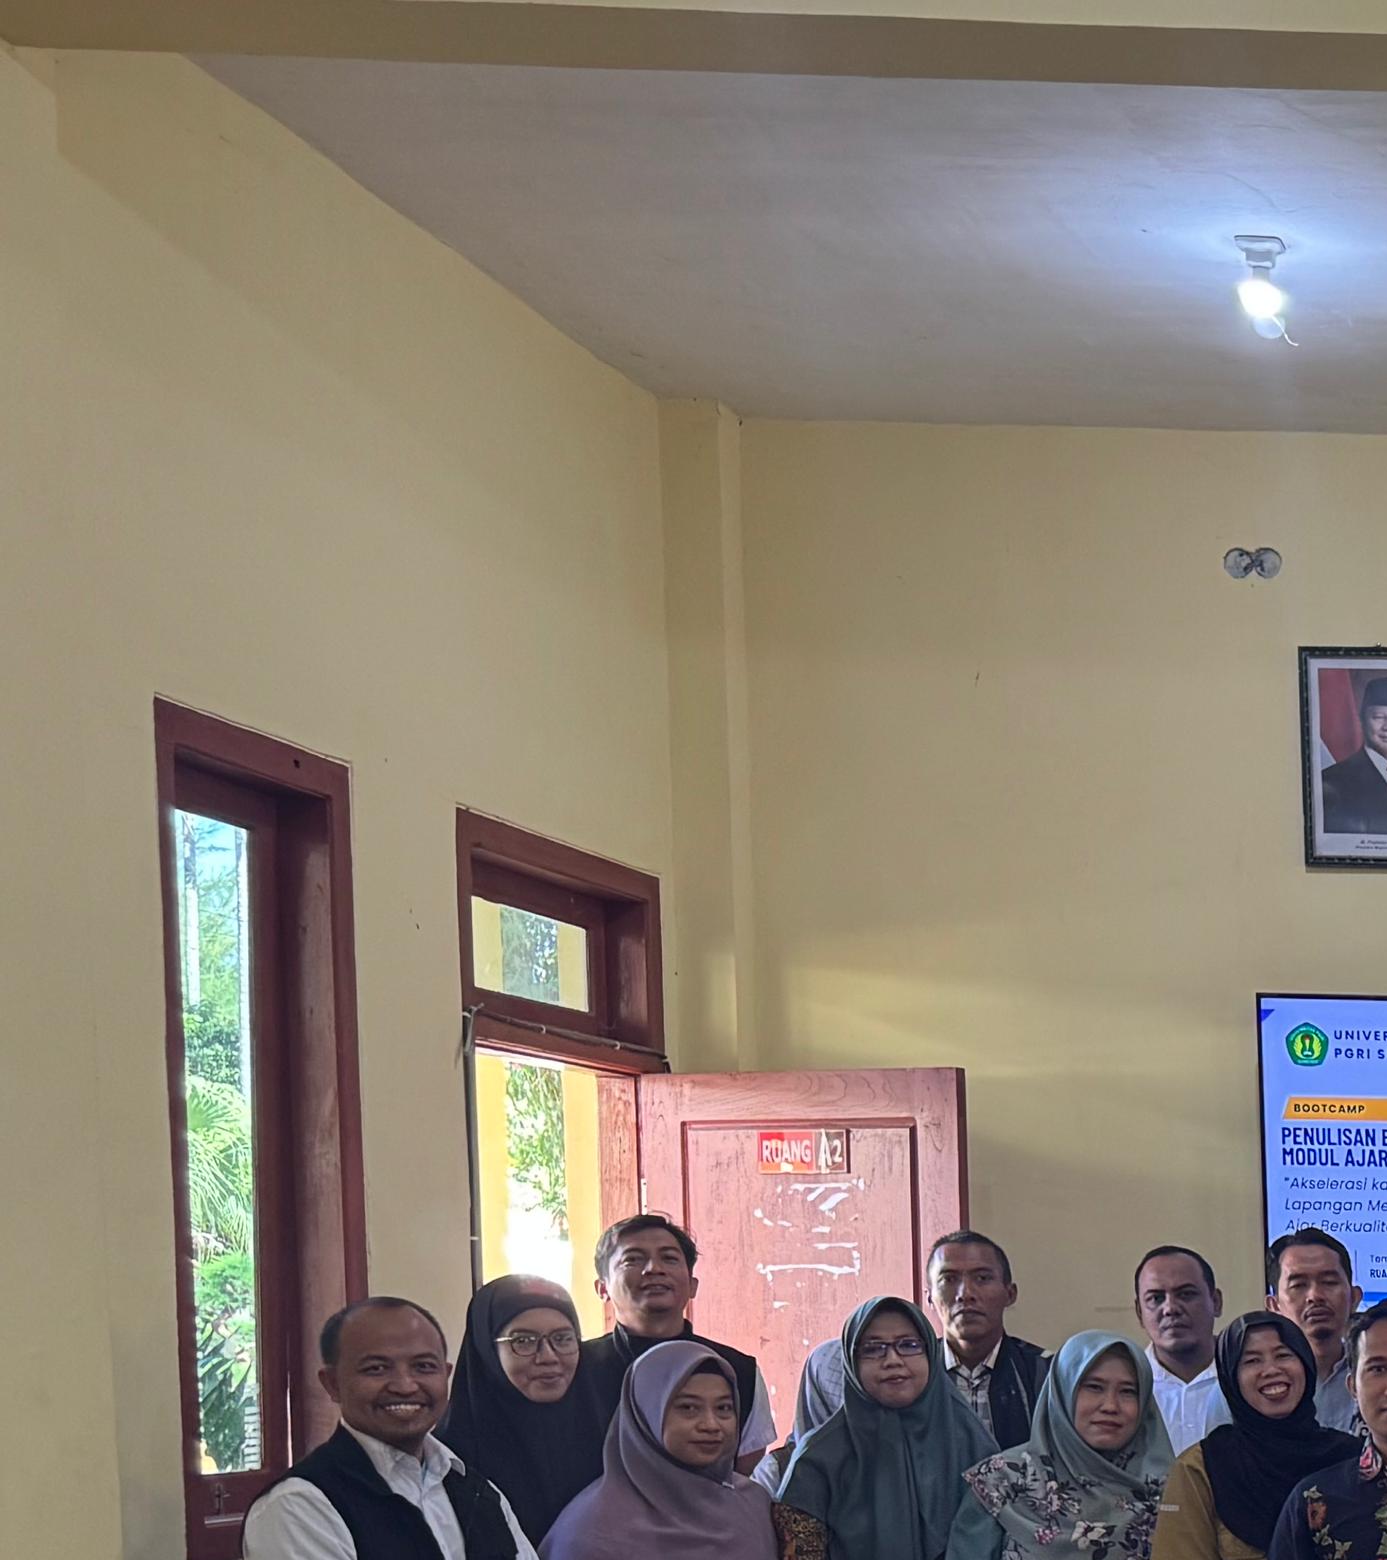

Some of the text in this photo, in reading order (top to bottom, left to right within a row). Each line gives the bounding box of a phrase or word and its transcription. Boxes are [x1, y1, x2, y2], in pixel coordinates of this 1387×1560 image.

[1333, 1047, 1371, 1060] PGRI
[1293, 1103, 1366, 1115] BOOTCAMP
[1281, 1127, 1376, 1147] PENULISAN
[761, 1139, 812, 1163] RUANG
[1282, 1148, 1340, 1167] MODUL
[1284, 1200, 1363, 1215] Lapangan
